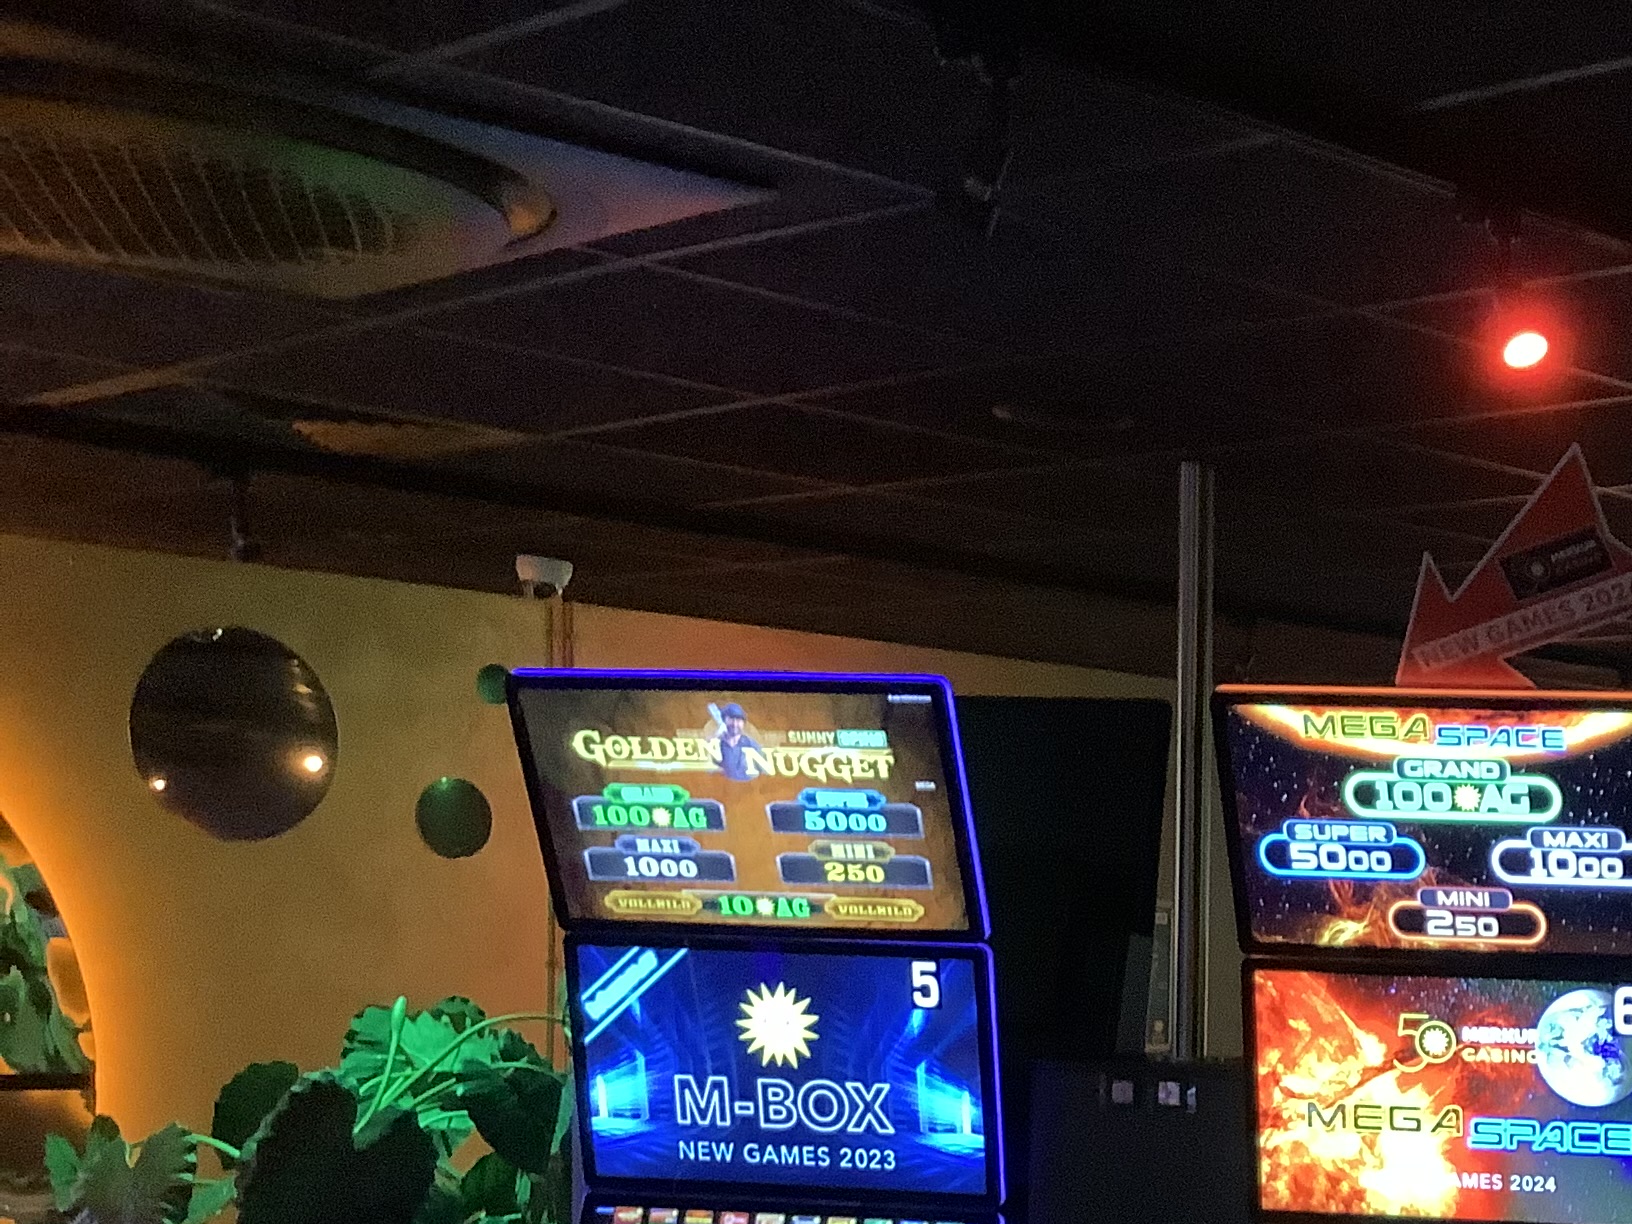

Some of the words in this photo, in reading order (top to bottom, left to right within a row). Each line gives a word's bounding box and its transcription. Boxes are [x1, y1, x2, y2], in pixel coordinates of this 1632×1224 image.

[1421, 631, 1479, 669] NEW
[1486, 599, 1577, 642] GAMES
[788, 730, 835, 744] SUNNY
[1303, 711, 1432, 742] MEGA
[1435, 724, 1568, 753] SPACE
[572, 729, 723, 767] GOLDEN
[742, 747, 895, 784] NUGGET
[1403, 760, 1501, 780] GRAND
[1374, 779, 1453, 812] 100
[1480, 782, 1531, 815] AG
[592, 805, 650, 827] 100
[673, 807, 707, 829] AG
[804, 810, 887, 832] 5000
[1294, 824, 1388, 843] SUPER
[1542, 831, 1608, 849] MAXI
[635, 838, 681, 854] MAXI
[624, 856, 698, 878] 1000
[1290, 844, 1392, 872] 5000
[1529, 849, 1624, 880] 1000
[824, 862, 885, 883] 250
[718, 895, 754, 916] 10
[776, 897, 811, 918] AG
[1437, 890, 1490, 908] MINI
[1425, 910, 1499, 937] 250
[911, 960, 940, 1008] 5
[1461, 1046, 1538, 1064] CASINO
[674, 1074, 896, 1135] M-BOX
[1306, 1101, 1464, 1138] MEGA
[678, 1140, 735, 1162] NEW
[743, 1142, 830, 1167] GAMES
[839, 1149, 897, 1171] 2023
[1450, 1172, 1503, 1191] AMES
[1510, 1174, 1557, 1193] 2024
